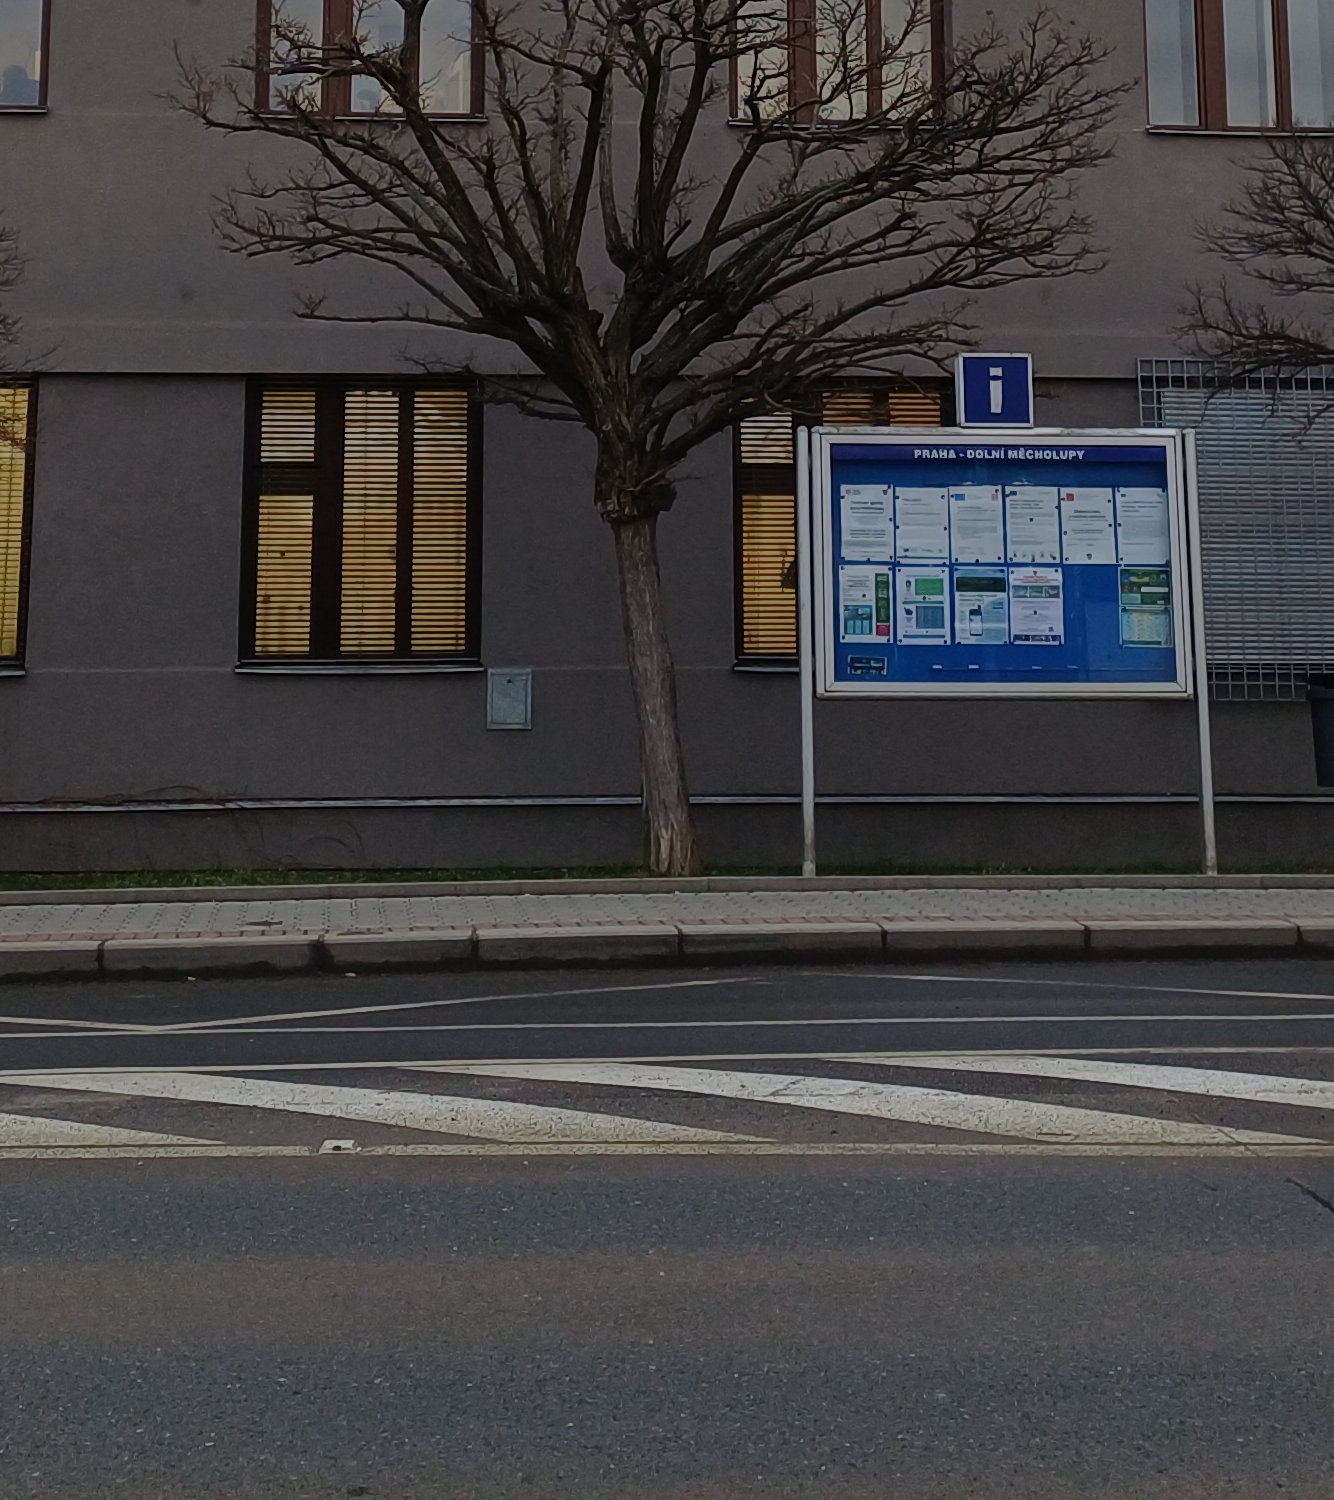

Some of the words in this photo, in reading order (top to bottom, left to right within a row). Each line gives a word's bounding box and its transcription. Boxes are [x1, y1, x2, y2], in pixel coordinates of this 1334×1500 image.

[989, 366, 1003, 414] i
[913, 449, 957, 459] PRAHA
[966, 447, 1005, 460] DOLNÍ
[1007, 447, 1086, 461] MĚCHOLUPY
